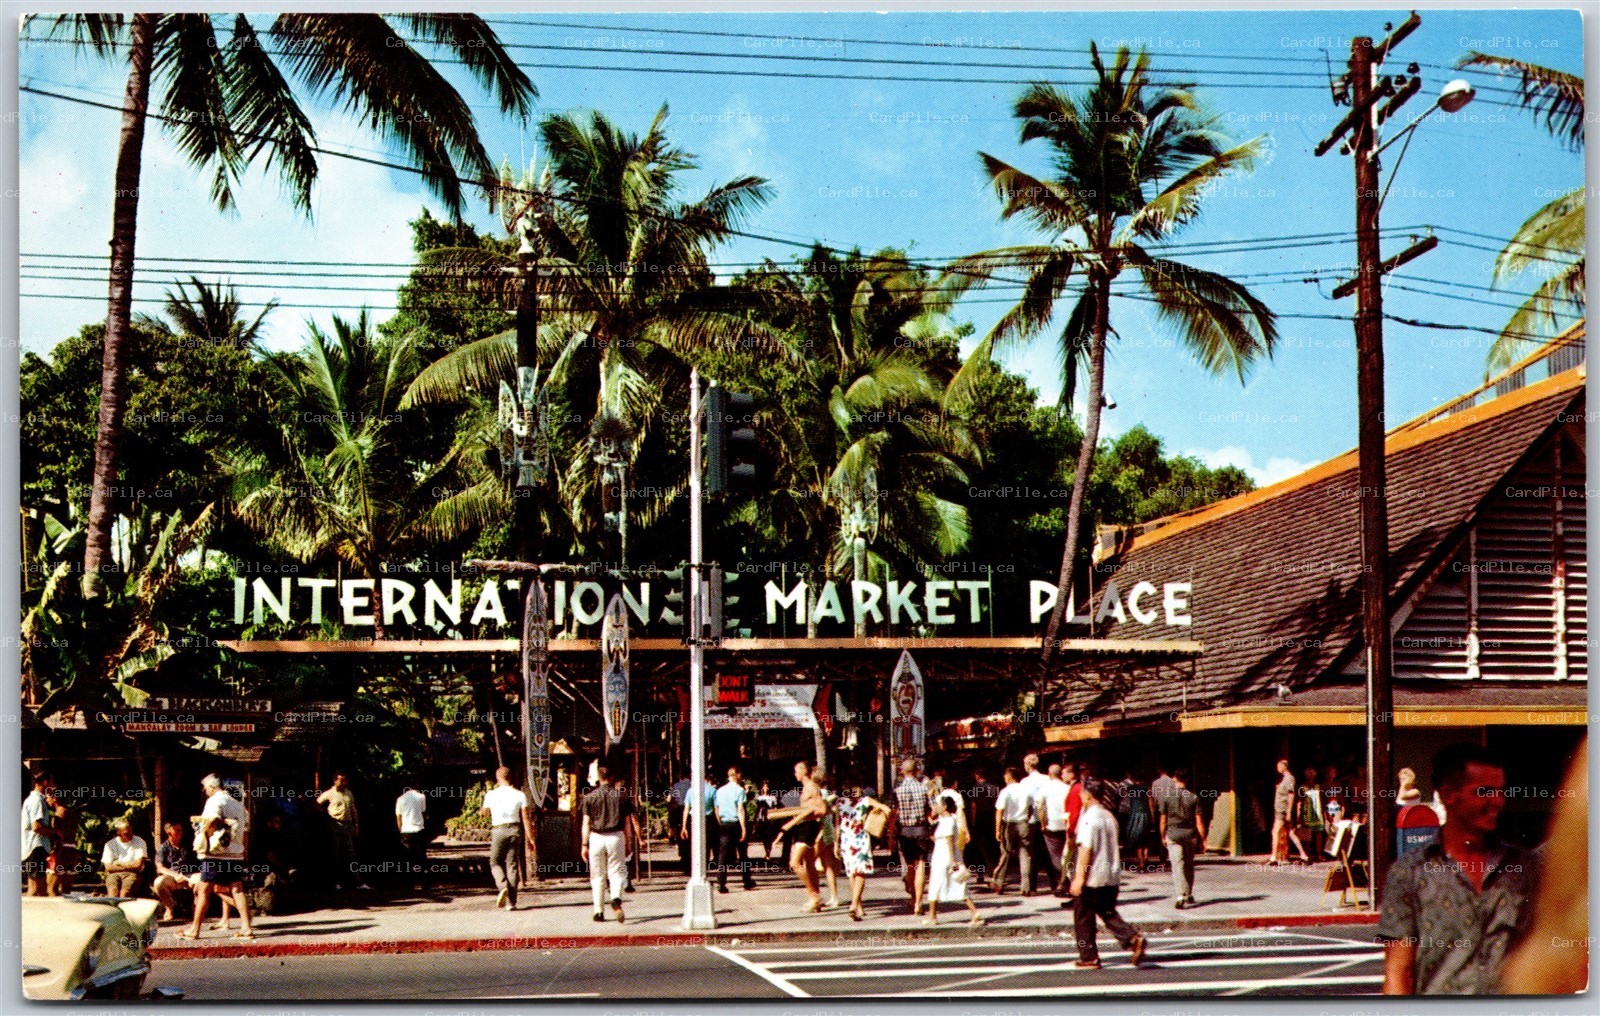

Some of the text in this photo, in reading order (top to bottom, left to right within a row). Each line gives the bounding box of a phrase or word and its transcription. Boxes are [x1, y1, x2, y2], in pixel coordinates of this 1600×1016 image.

[233, 576, 1192, 627] INTERNAIONL MARKET PLACE
[717, 690, 750, 703] WALK
